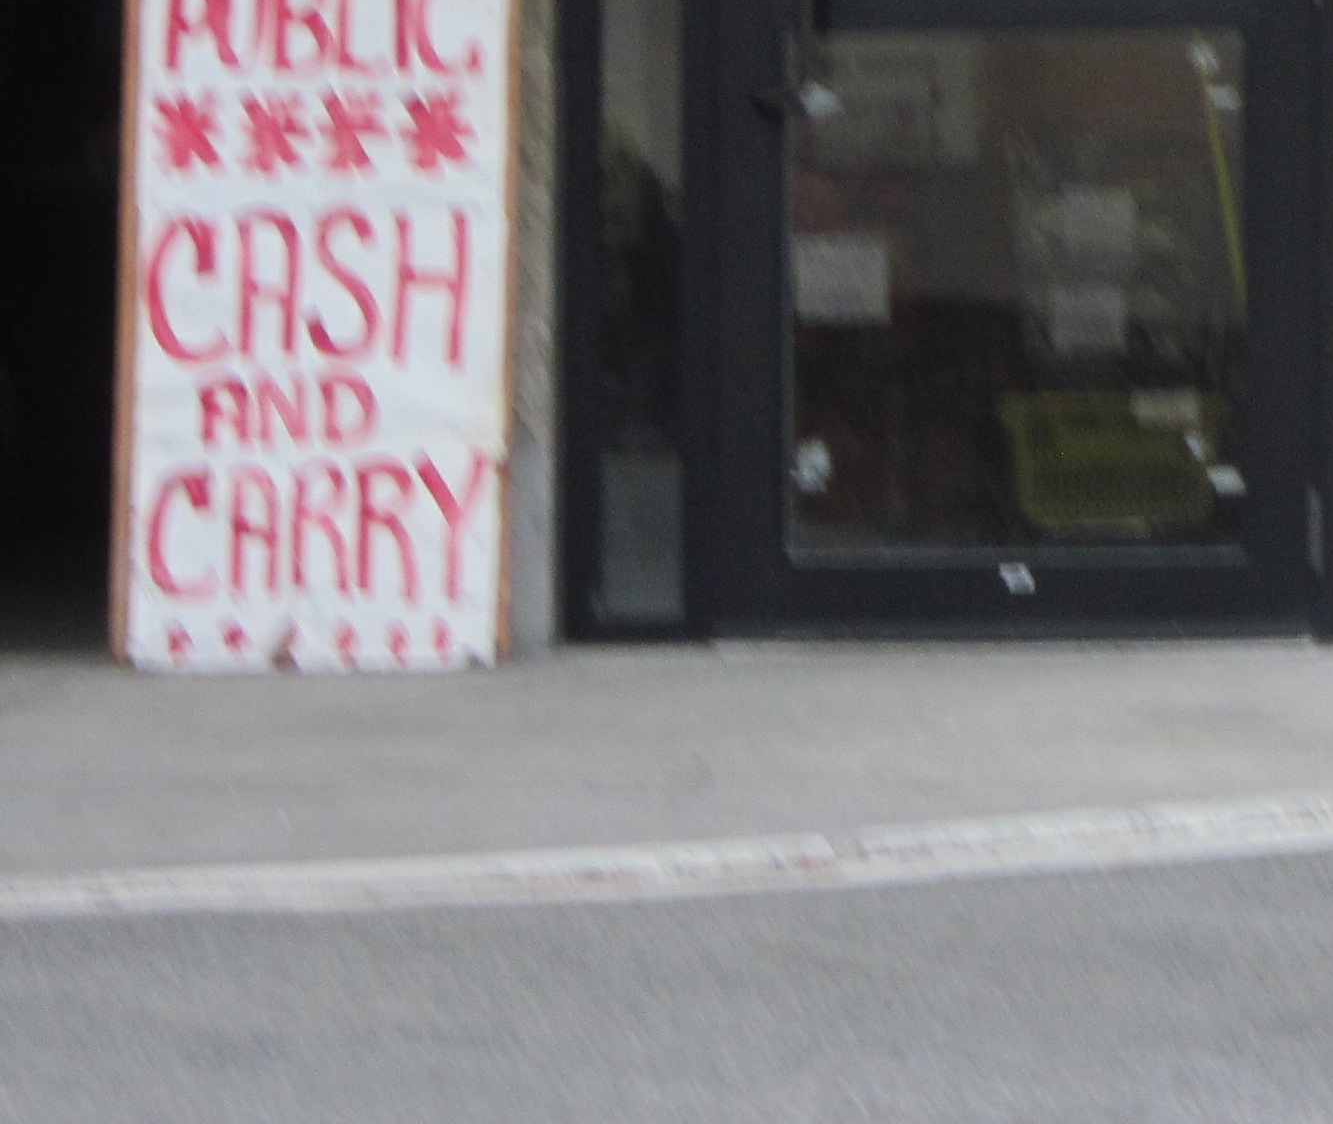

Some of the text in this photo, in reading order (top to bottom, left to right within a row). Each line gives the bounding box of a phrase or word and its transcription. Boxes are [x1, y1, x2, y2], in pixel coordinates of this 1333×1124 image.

[147, 208, 470, 368] CASH
[200, 374, 380, 448] AND
[147, 446, 490, 604] CARRY
